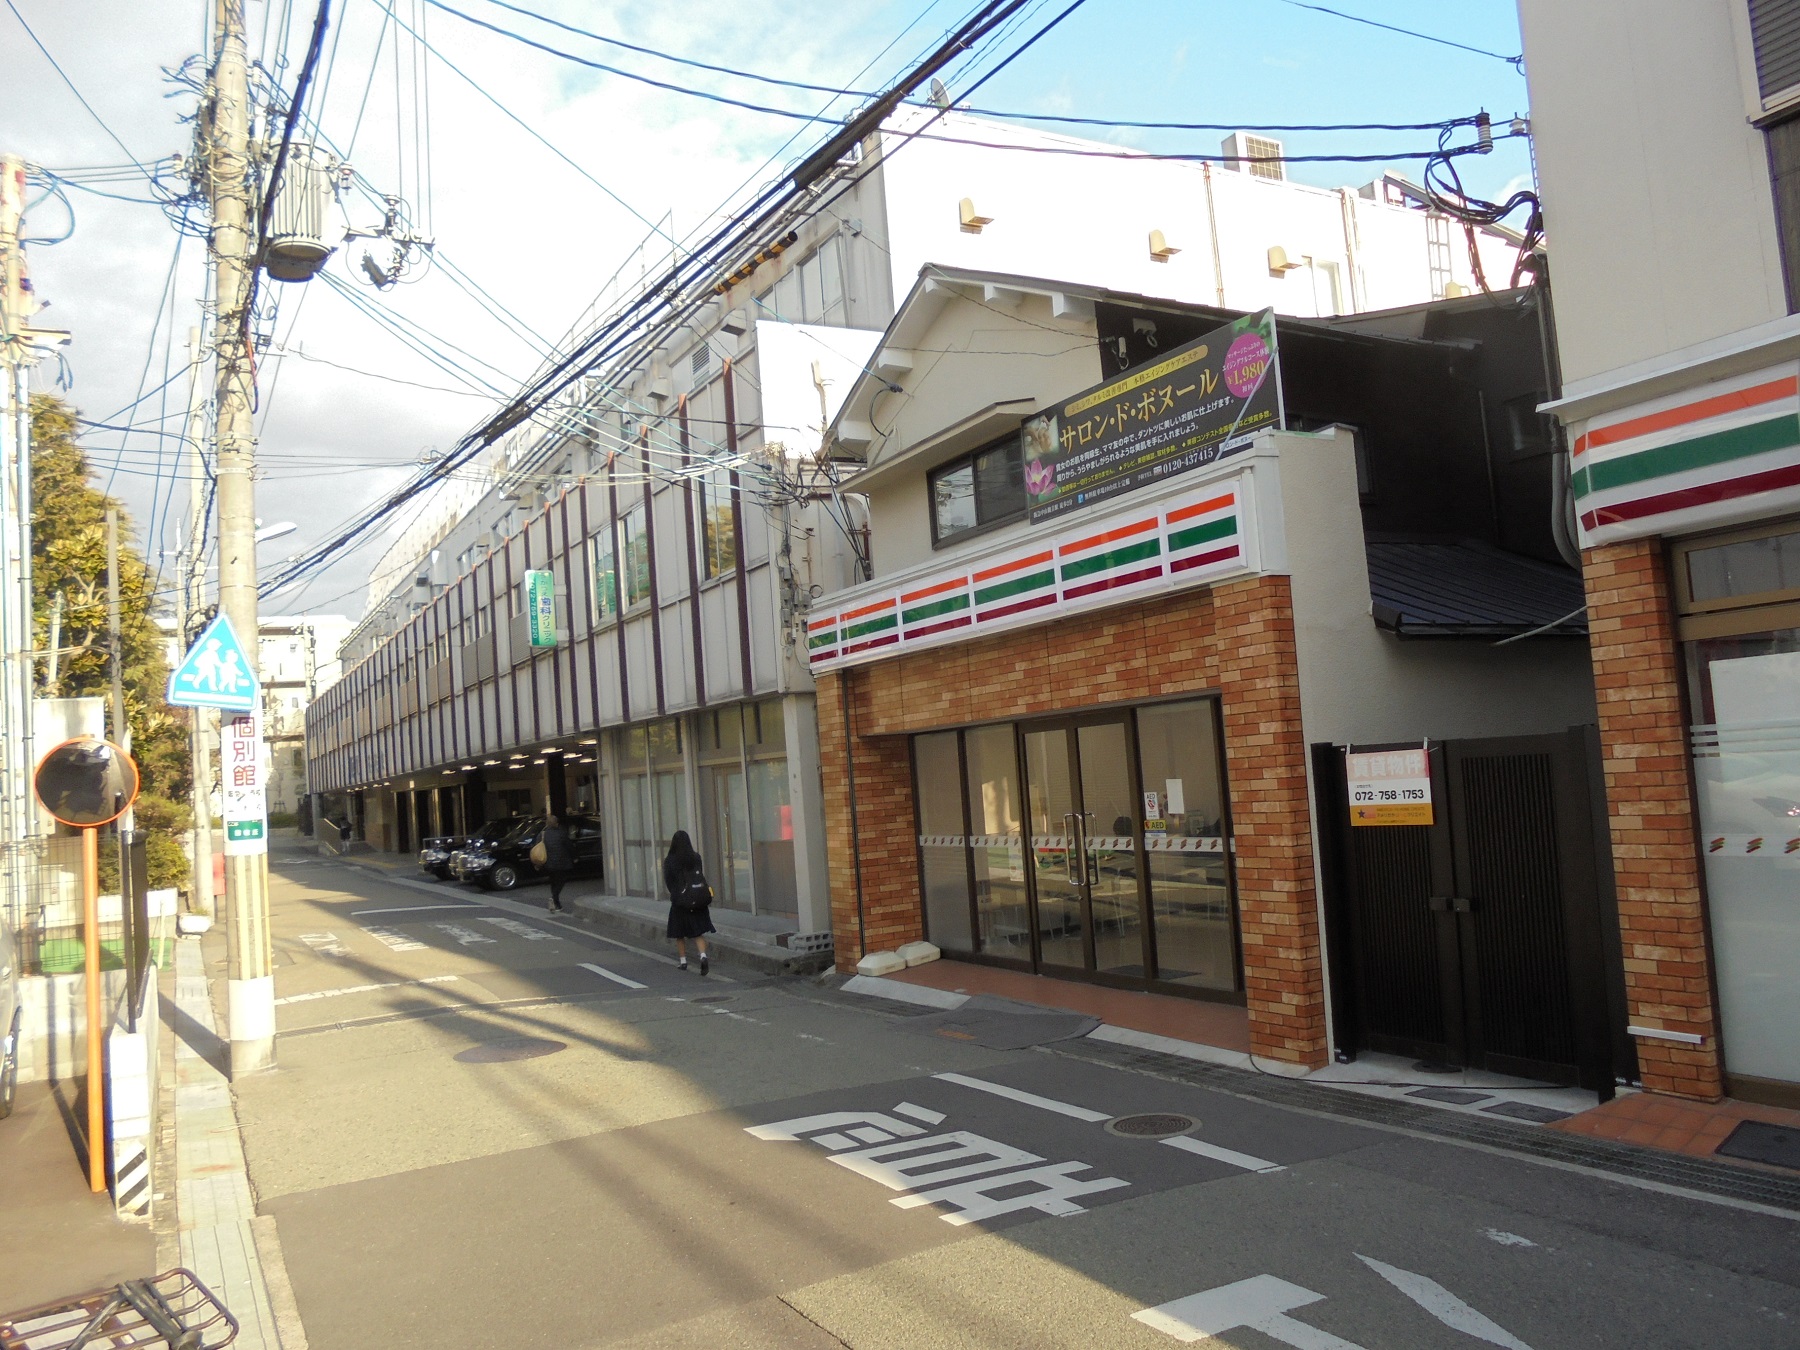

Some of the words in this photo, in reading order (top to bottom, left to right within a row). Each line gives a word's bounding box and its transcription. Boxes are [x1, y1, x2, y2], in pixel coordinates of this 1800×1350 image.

[1060, 369, 1219, 453] サロン・ド・ボヌール
[1162, 447, 1214, 474] 0120-437415
[231, 716, 256, 787] 個別館
[1352, 753, 1422, 778] 賃貸物件
[1354, 788, 1424, 801] 072-758-1753
[1151, 821, 1164, 829] AED
